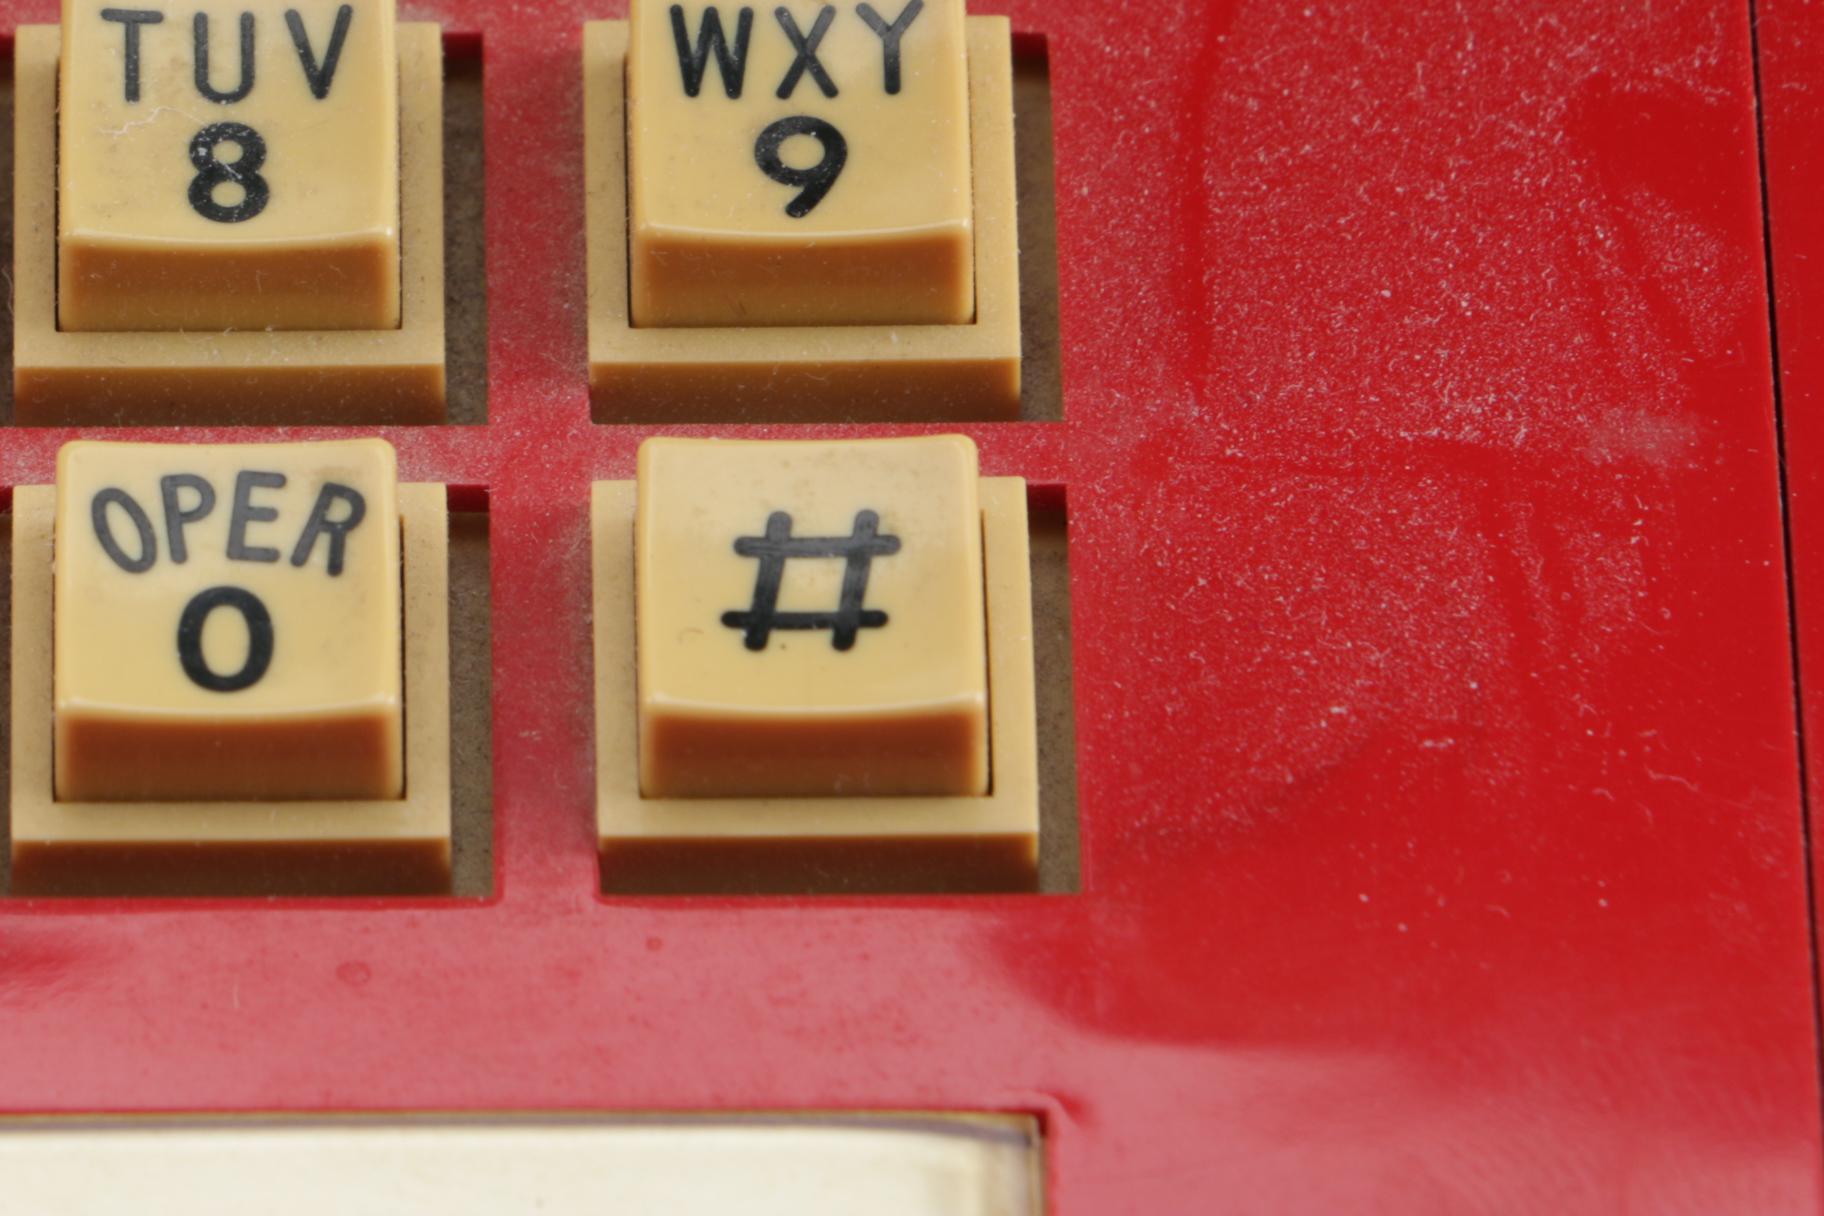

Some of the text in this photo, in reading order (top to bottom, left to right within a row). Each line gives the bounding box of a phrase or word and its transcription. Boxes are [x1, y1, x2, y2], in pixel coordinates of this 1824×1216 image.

[98, 2, 355, 108] TUV
[185, 119, 273, 226] 8
[751, 112, 851, 221] 9
[89, 468, 369, 580] OPER
[174, 583, 277, 696] 0
